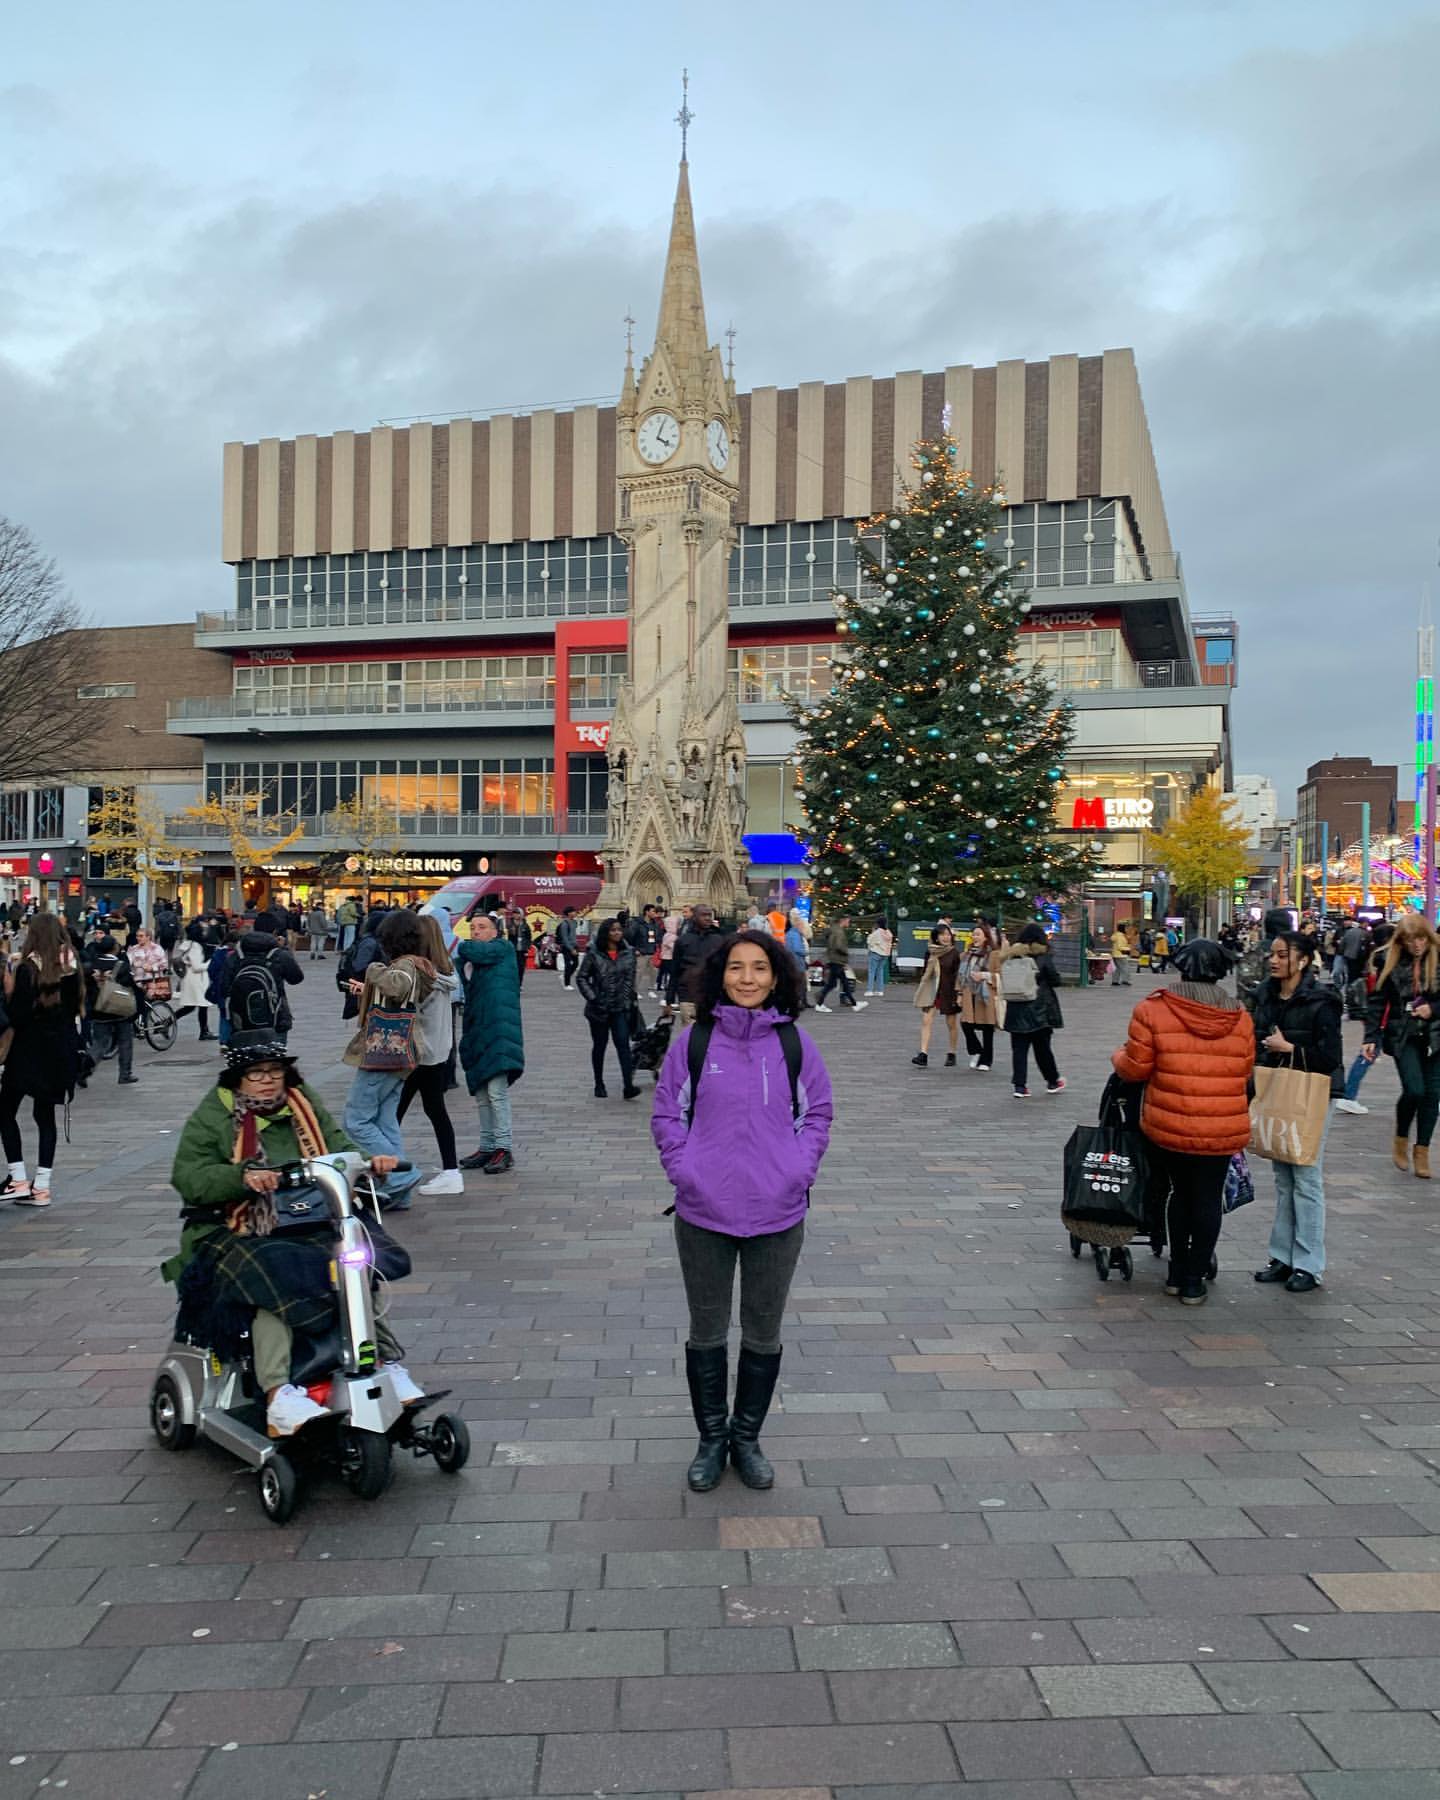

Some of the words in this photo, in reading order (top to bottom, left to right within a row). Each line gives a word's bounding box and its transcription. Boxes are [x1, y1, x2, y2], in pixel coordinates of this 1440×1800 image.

[1073, 796, 1153, 829] METRO
[1105, 816, 1153, 828] BANK
[365, 858, 423, 872] BURGER
[424, 858, 463, 872] KING
[534, 877, 564, 887] COSTA
